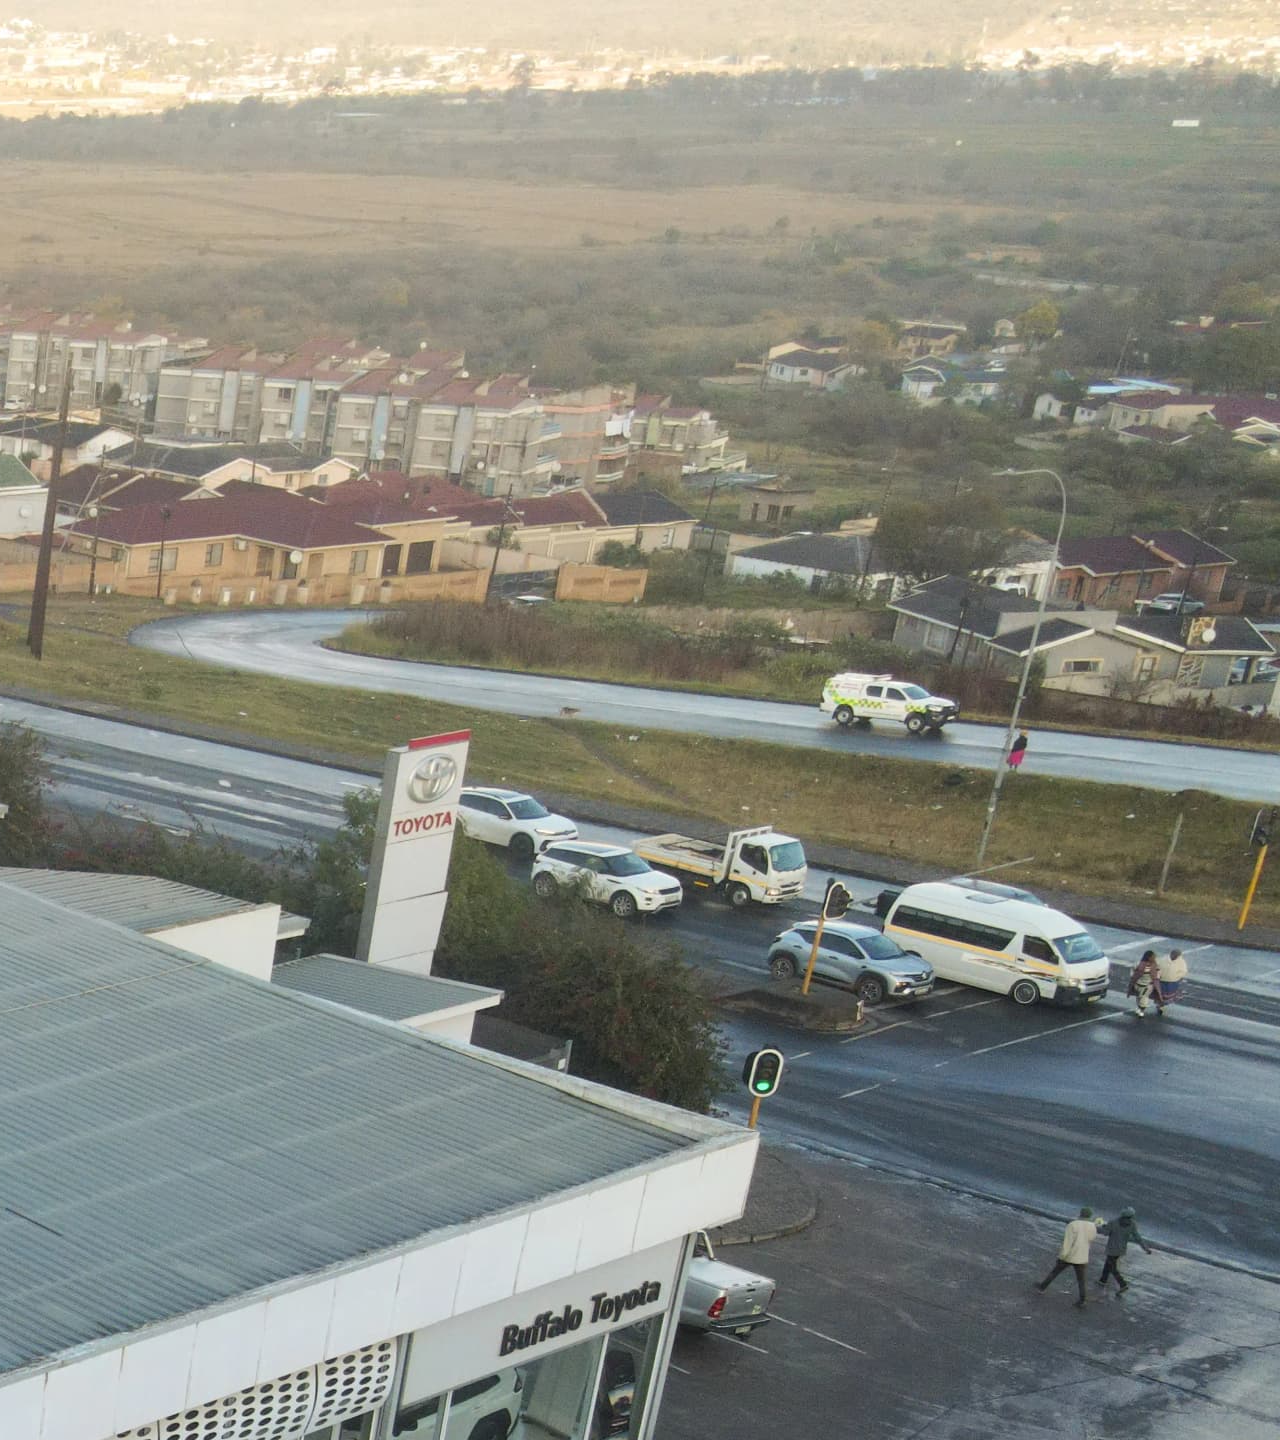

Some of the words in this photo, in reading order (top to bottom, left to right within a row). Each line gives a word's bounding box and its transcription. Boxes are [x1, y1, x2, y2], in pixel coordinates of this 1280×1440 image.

[393, 811, 452, 837] TOYOTA
[499, 1304, 583, 1356] Buffalo
[590, 1280, 661, 1323] Toyota
